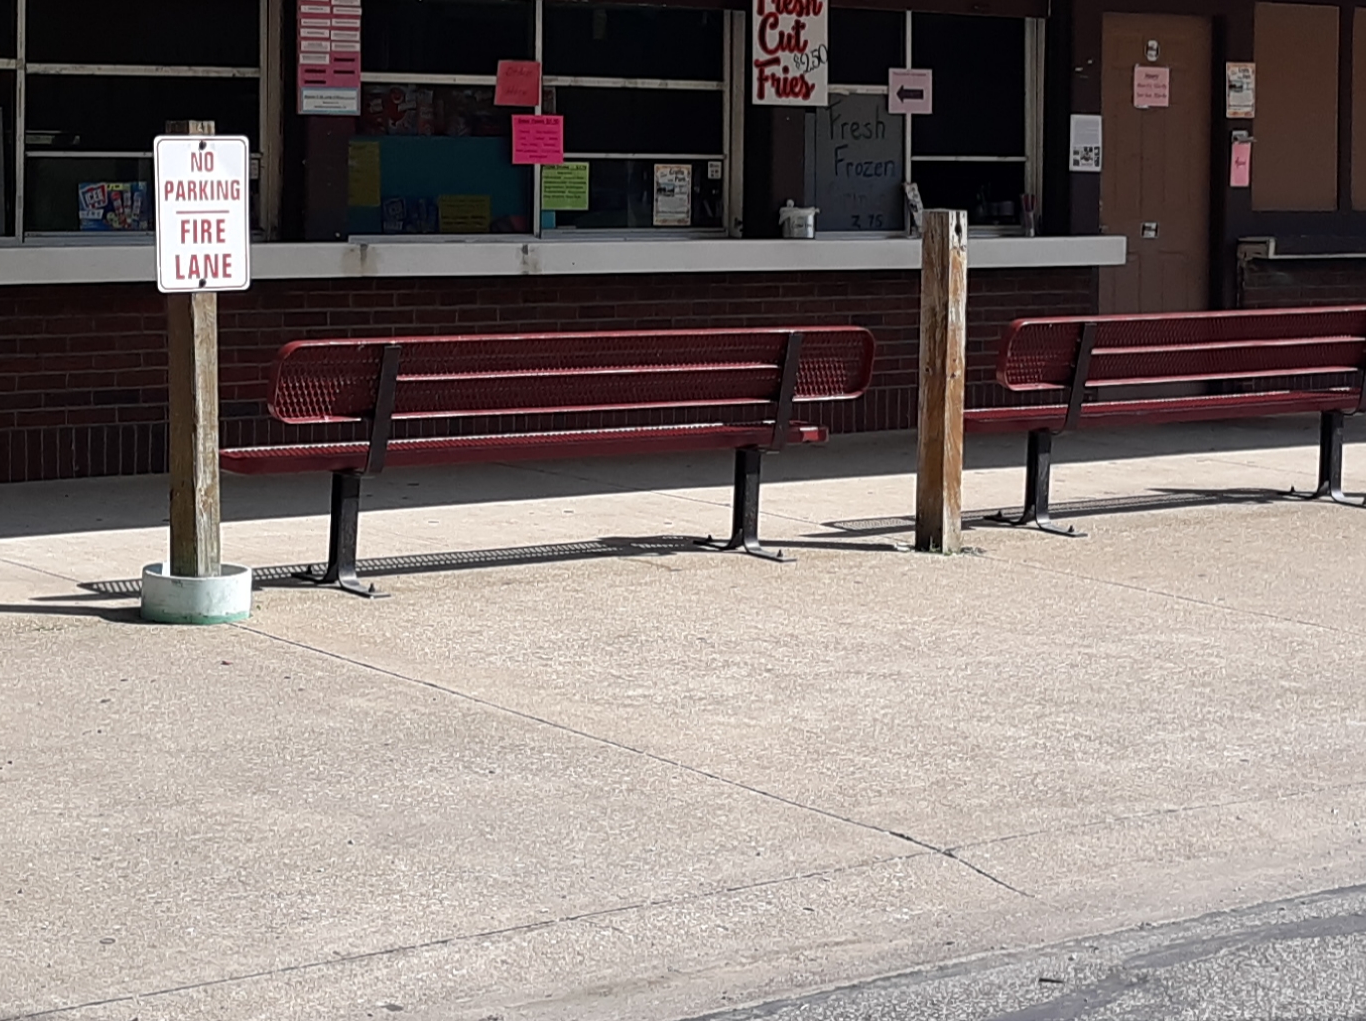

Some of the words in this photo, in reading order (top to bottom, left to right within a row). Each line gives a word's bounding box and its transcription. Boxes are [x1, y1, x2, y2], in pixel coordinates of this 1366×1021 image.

[759, 12, 808, 56] Cut
[754, 58, 815, 100] Fries
[827, 99, 886, 140] Fresh
[191, 151, 215, 173] NO
[834, 145, 896, 178] Frozen
[164, 180, 241, 202] PARKING
[180, 219, 226, 245] FIRE
[175, 253, 232, 281] LANE
